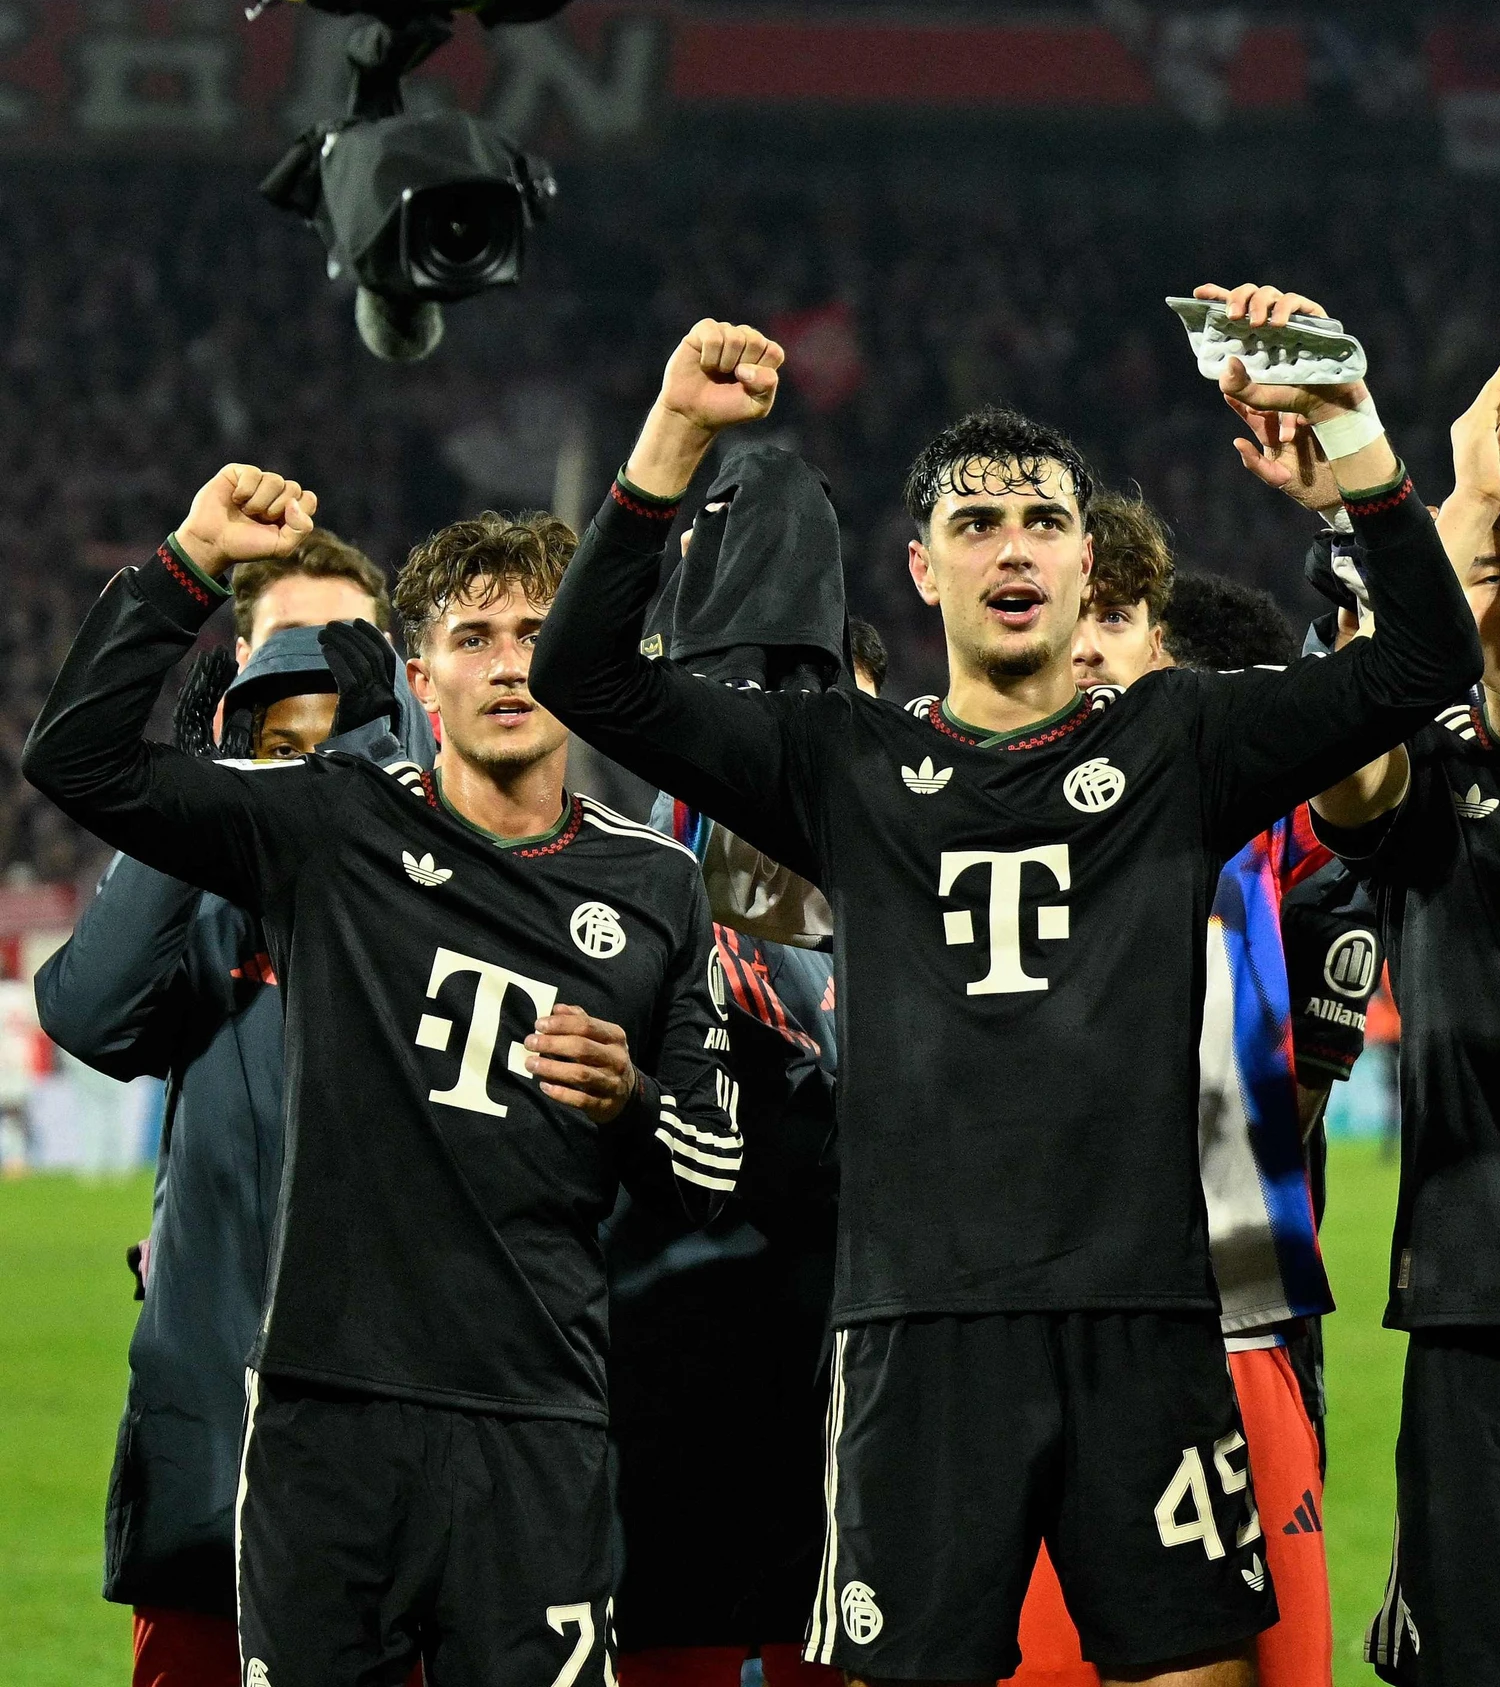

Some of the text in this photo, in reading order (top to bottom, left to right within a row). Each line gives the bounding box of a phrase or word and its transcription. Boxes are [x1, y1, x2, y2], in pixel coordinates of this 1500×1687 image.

[938, 844, 1072, 996] T
[415, 947, 560, 1119] T
[1304, 997, 1367, 1032] Allian
